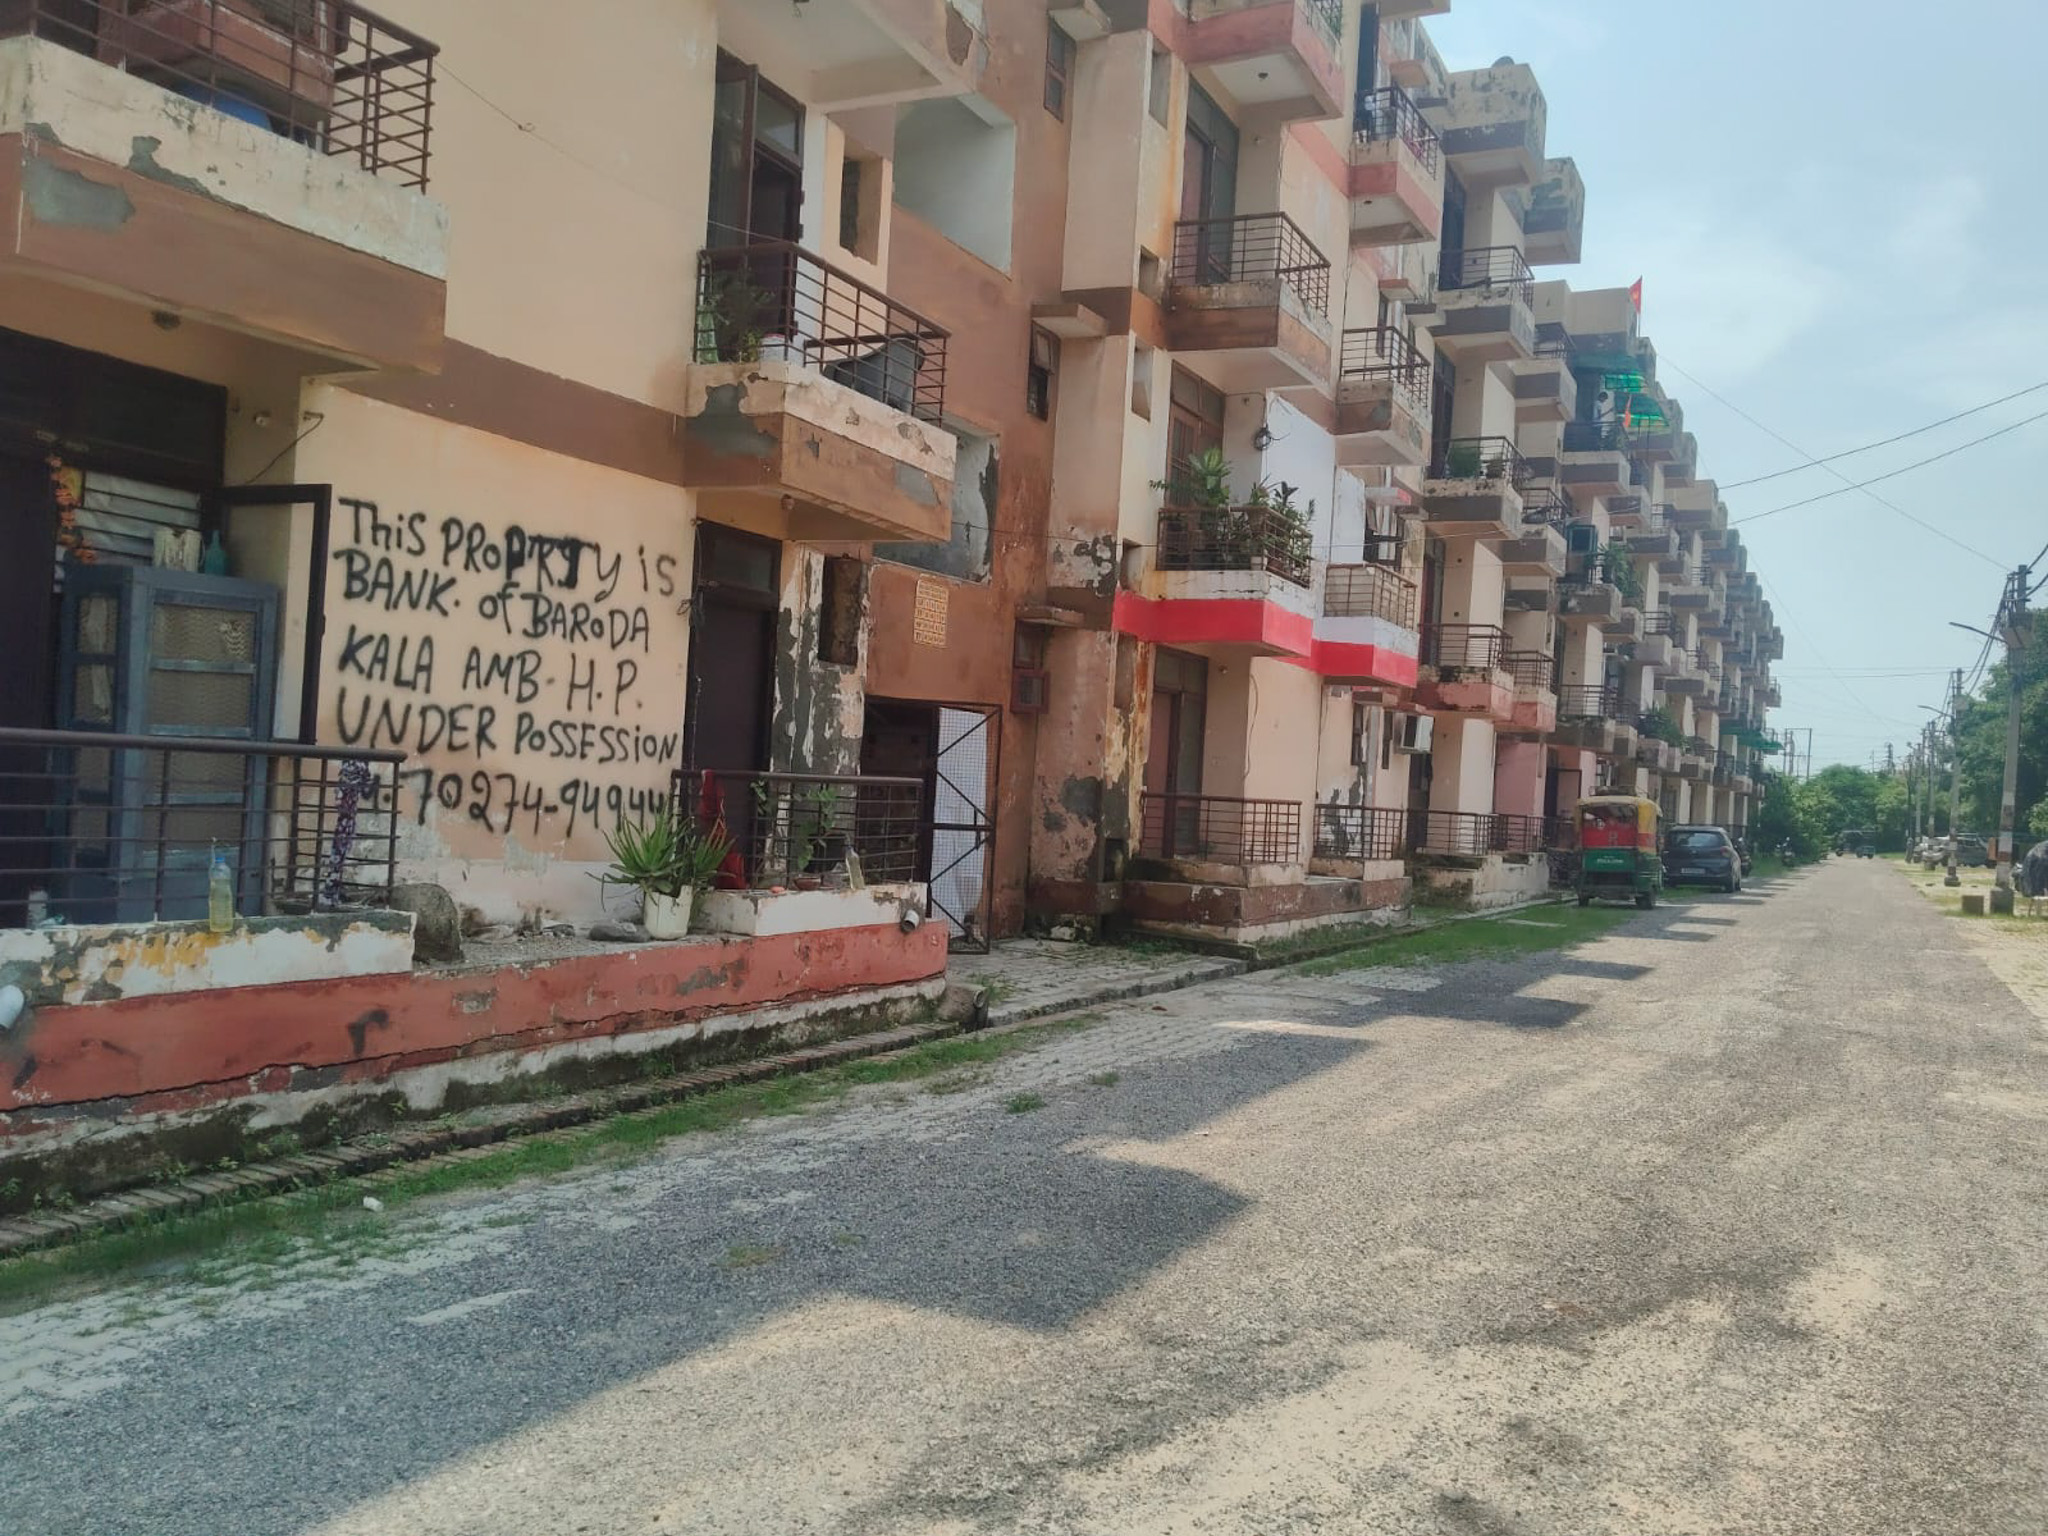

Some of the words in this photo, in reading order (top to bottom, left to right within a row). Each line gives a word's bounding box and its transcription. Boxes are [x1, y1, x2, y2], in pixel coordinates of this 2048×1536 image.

[338, 497, 426, 556] This
[338, 625, 434, 694] KALA
[336, 686, 496, 760] UNDER
